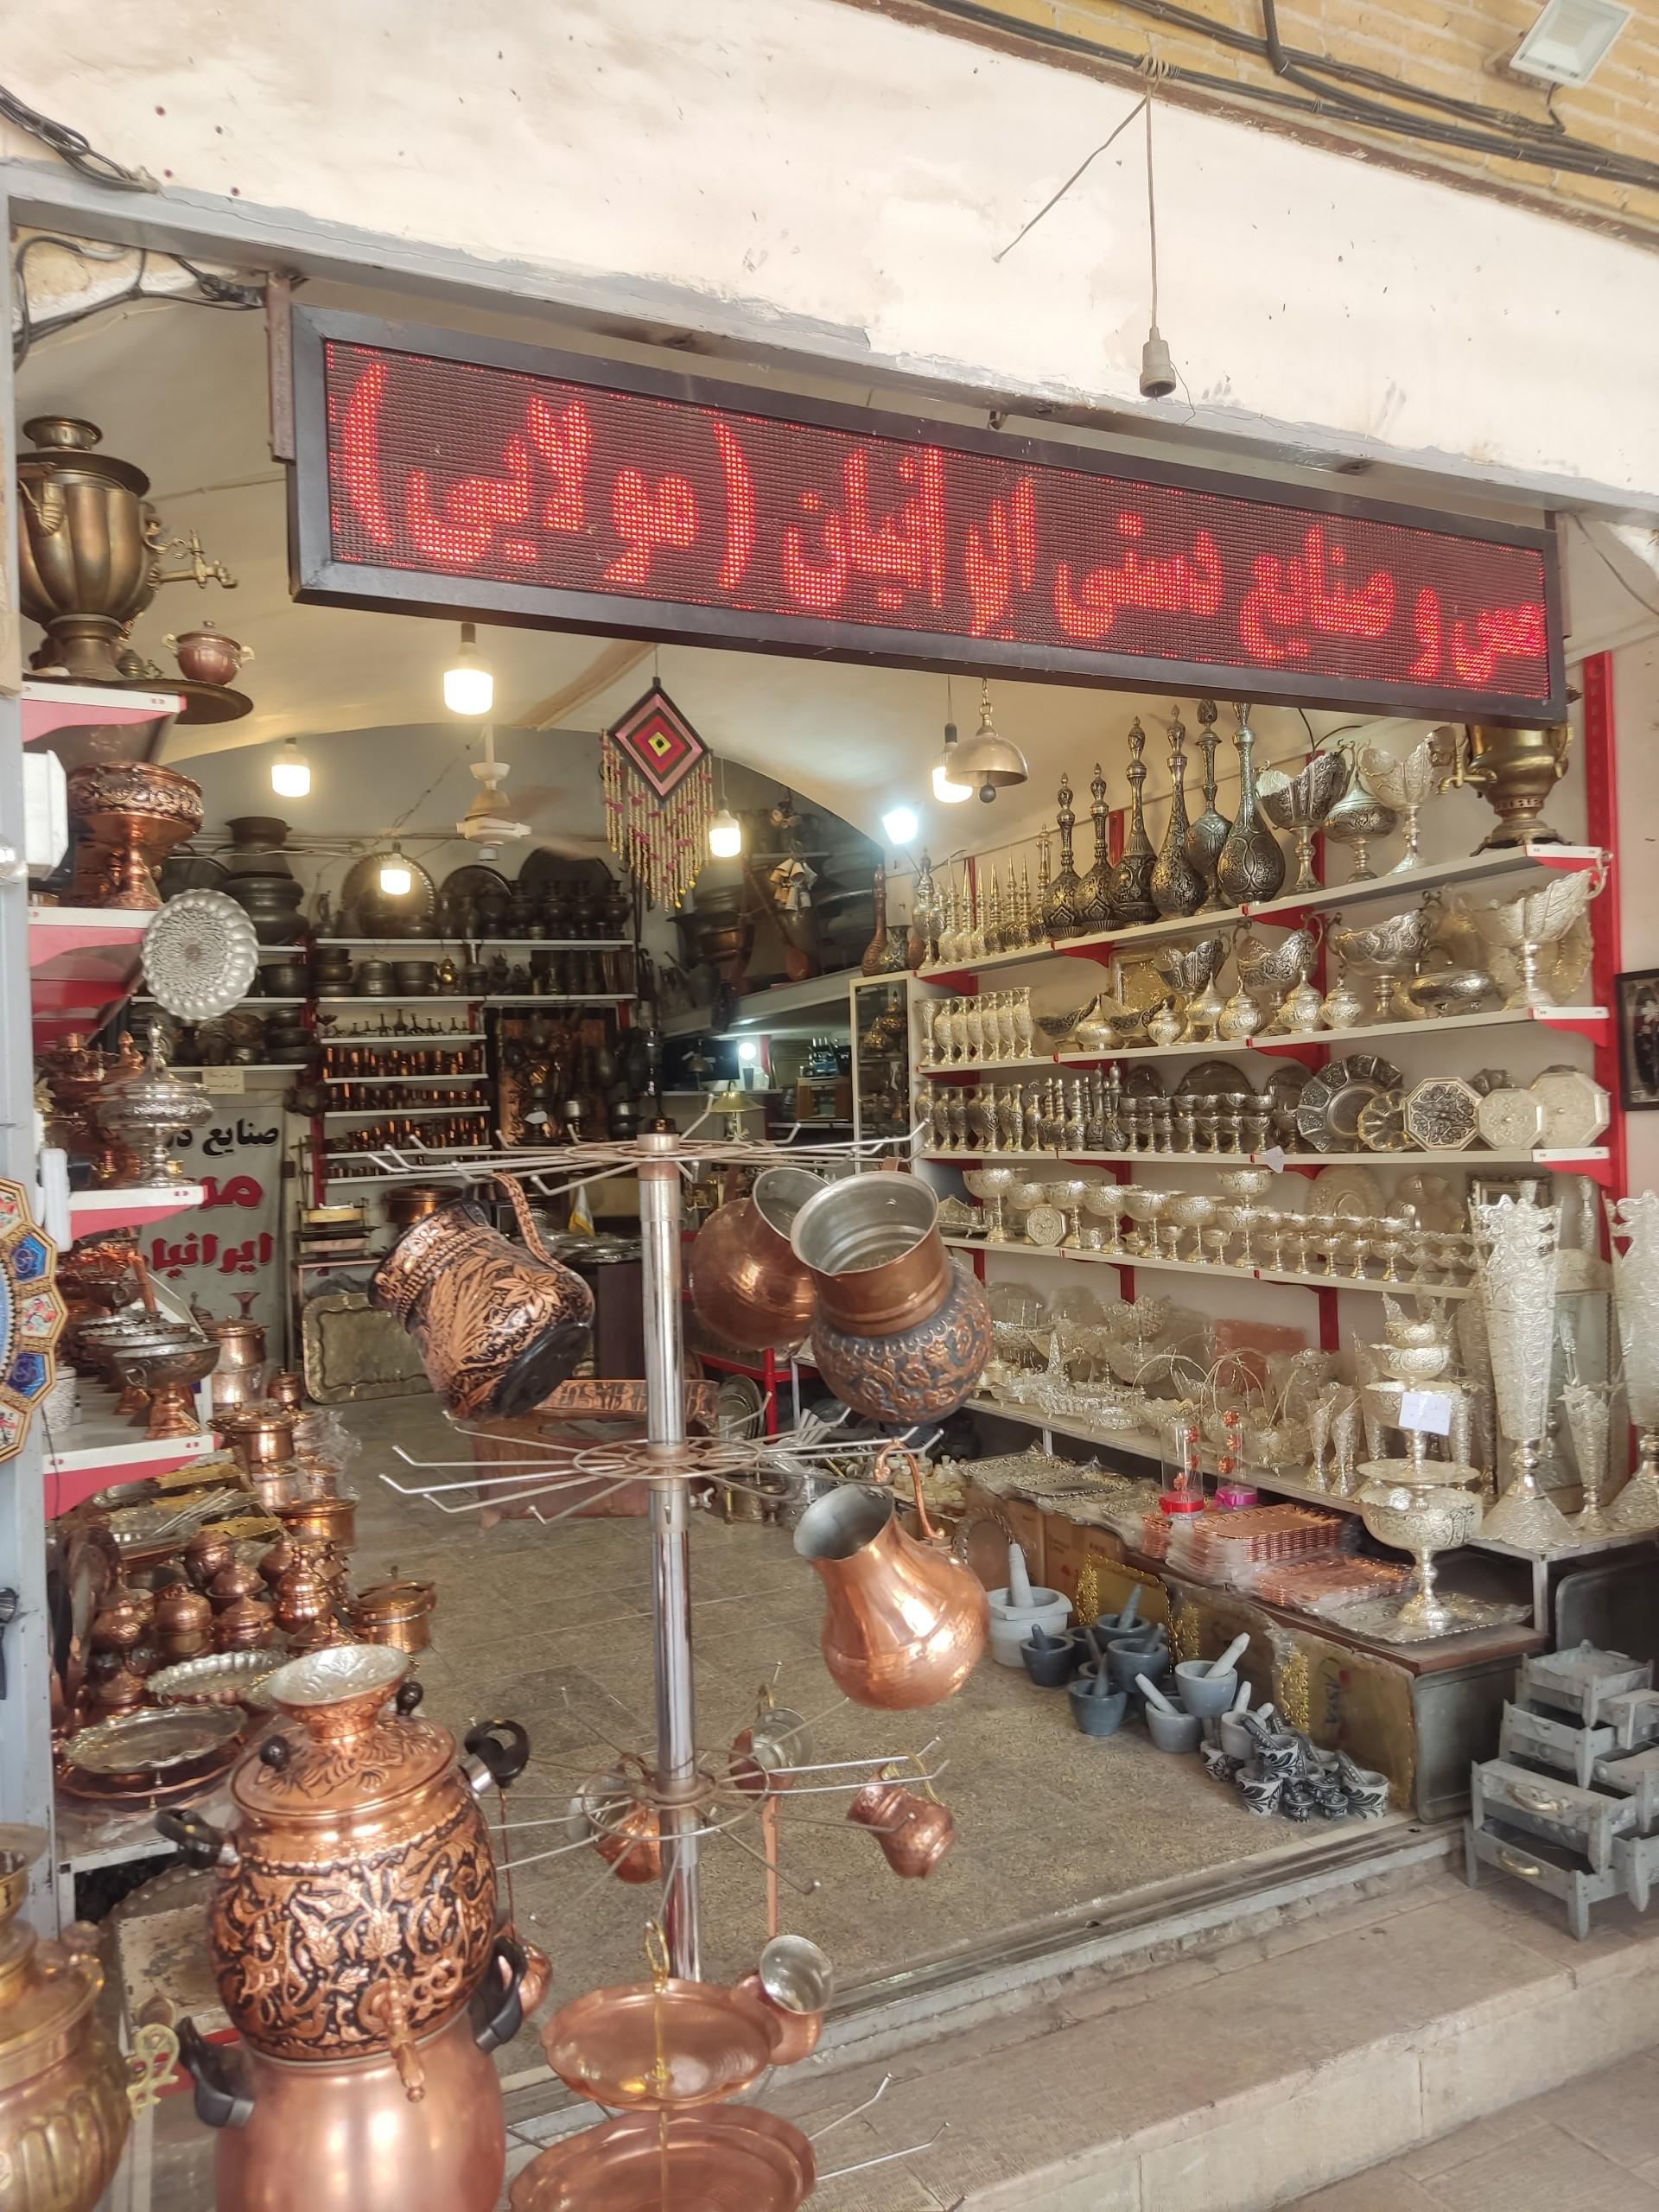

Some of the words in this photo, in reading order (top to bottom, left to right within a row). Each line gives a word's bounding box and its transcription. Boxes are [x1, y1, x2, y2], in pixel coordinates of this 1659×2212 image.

[1053, 512, 1224, 640] دستی
[1237, 524, 1394, 661] صنایع
[1408, 588, 1440, 678] و
[203, 1118, 279, 1156] صنایع
[143, 1232, 274, 1279] ایرانیا
